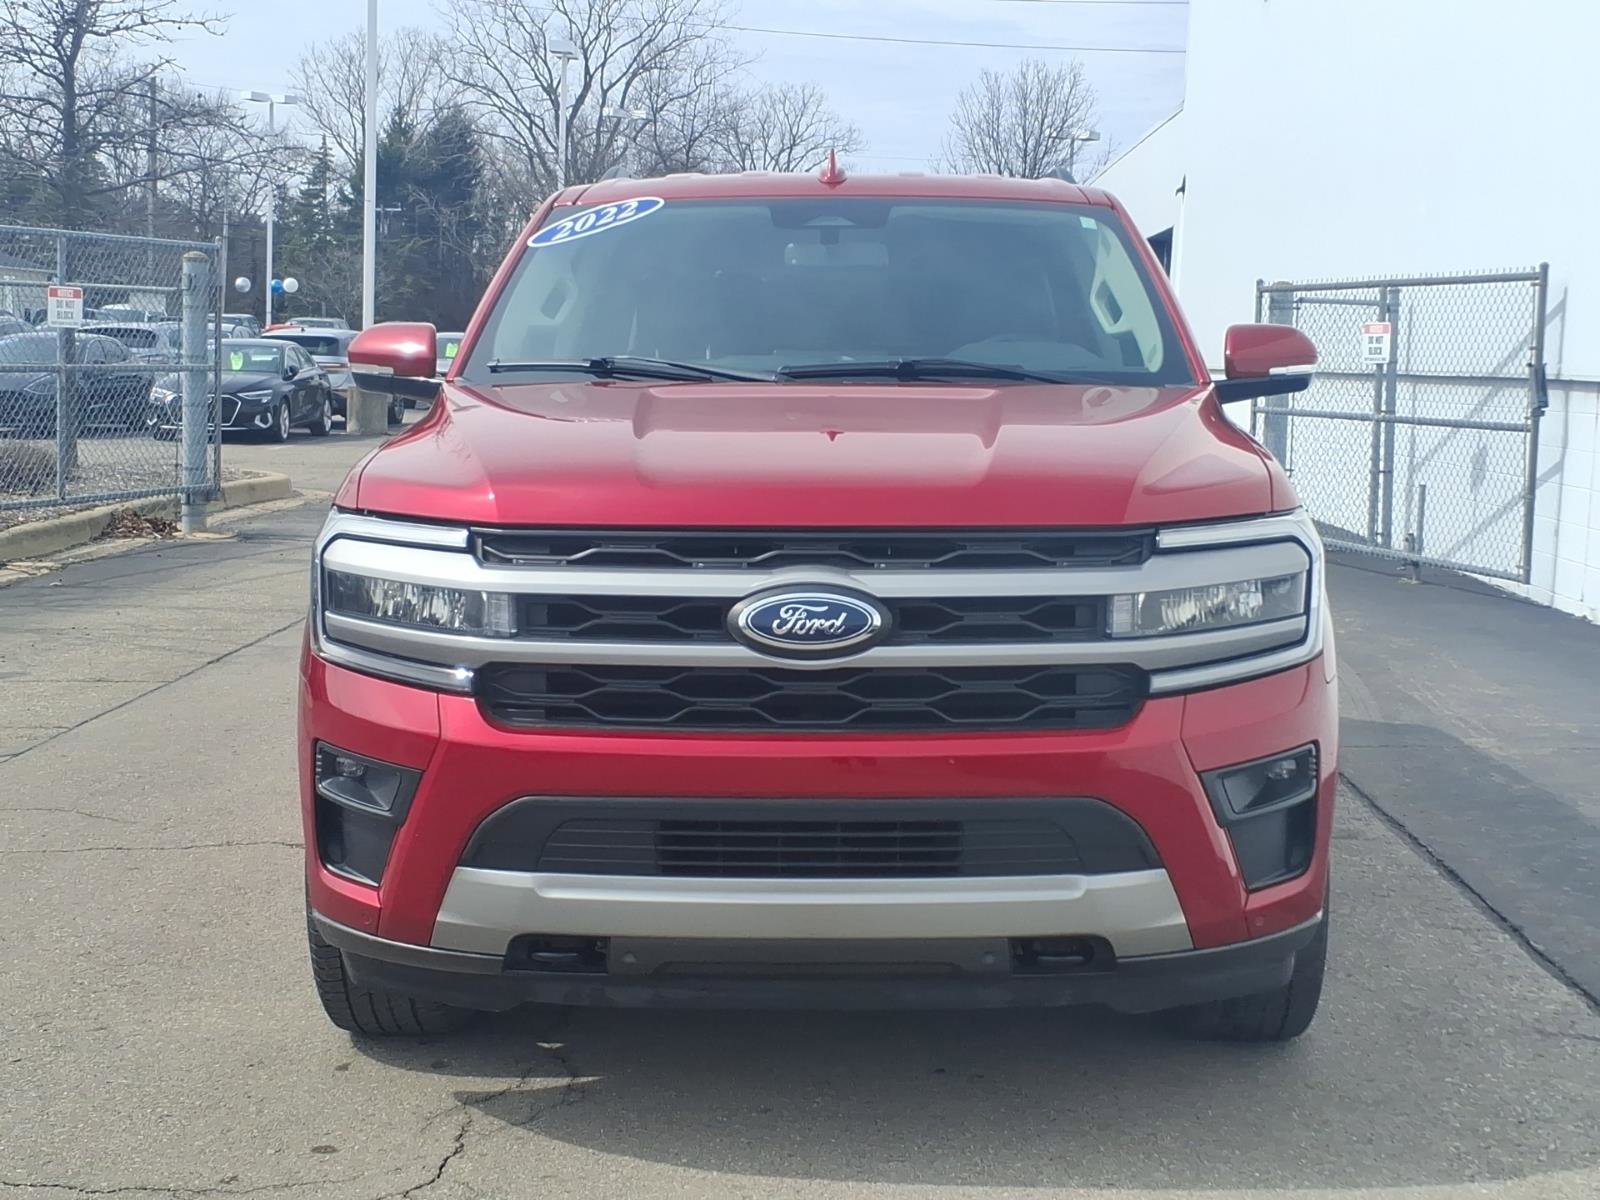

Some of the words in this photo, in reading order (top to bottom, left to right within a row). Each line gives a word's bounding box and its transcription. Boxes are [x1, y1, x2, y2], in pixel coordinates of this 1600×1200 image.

[551, 201, 639, 241] 2022
[57, 310, 74, 320] BLOCK
[772, 604, 848, 635] Ford
